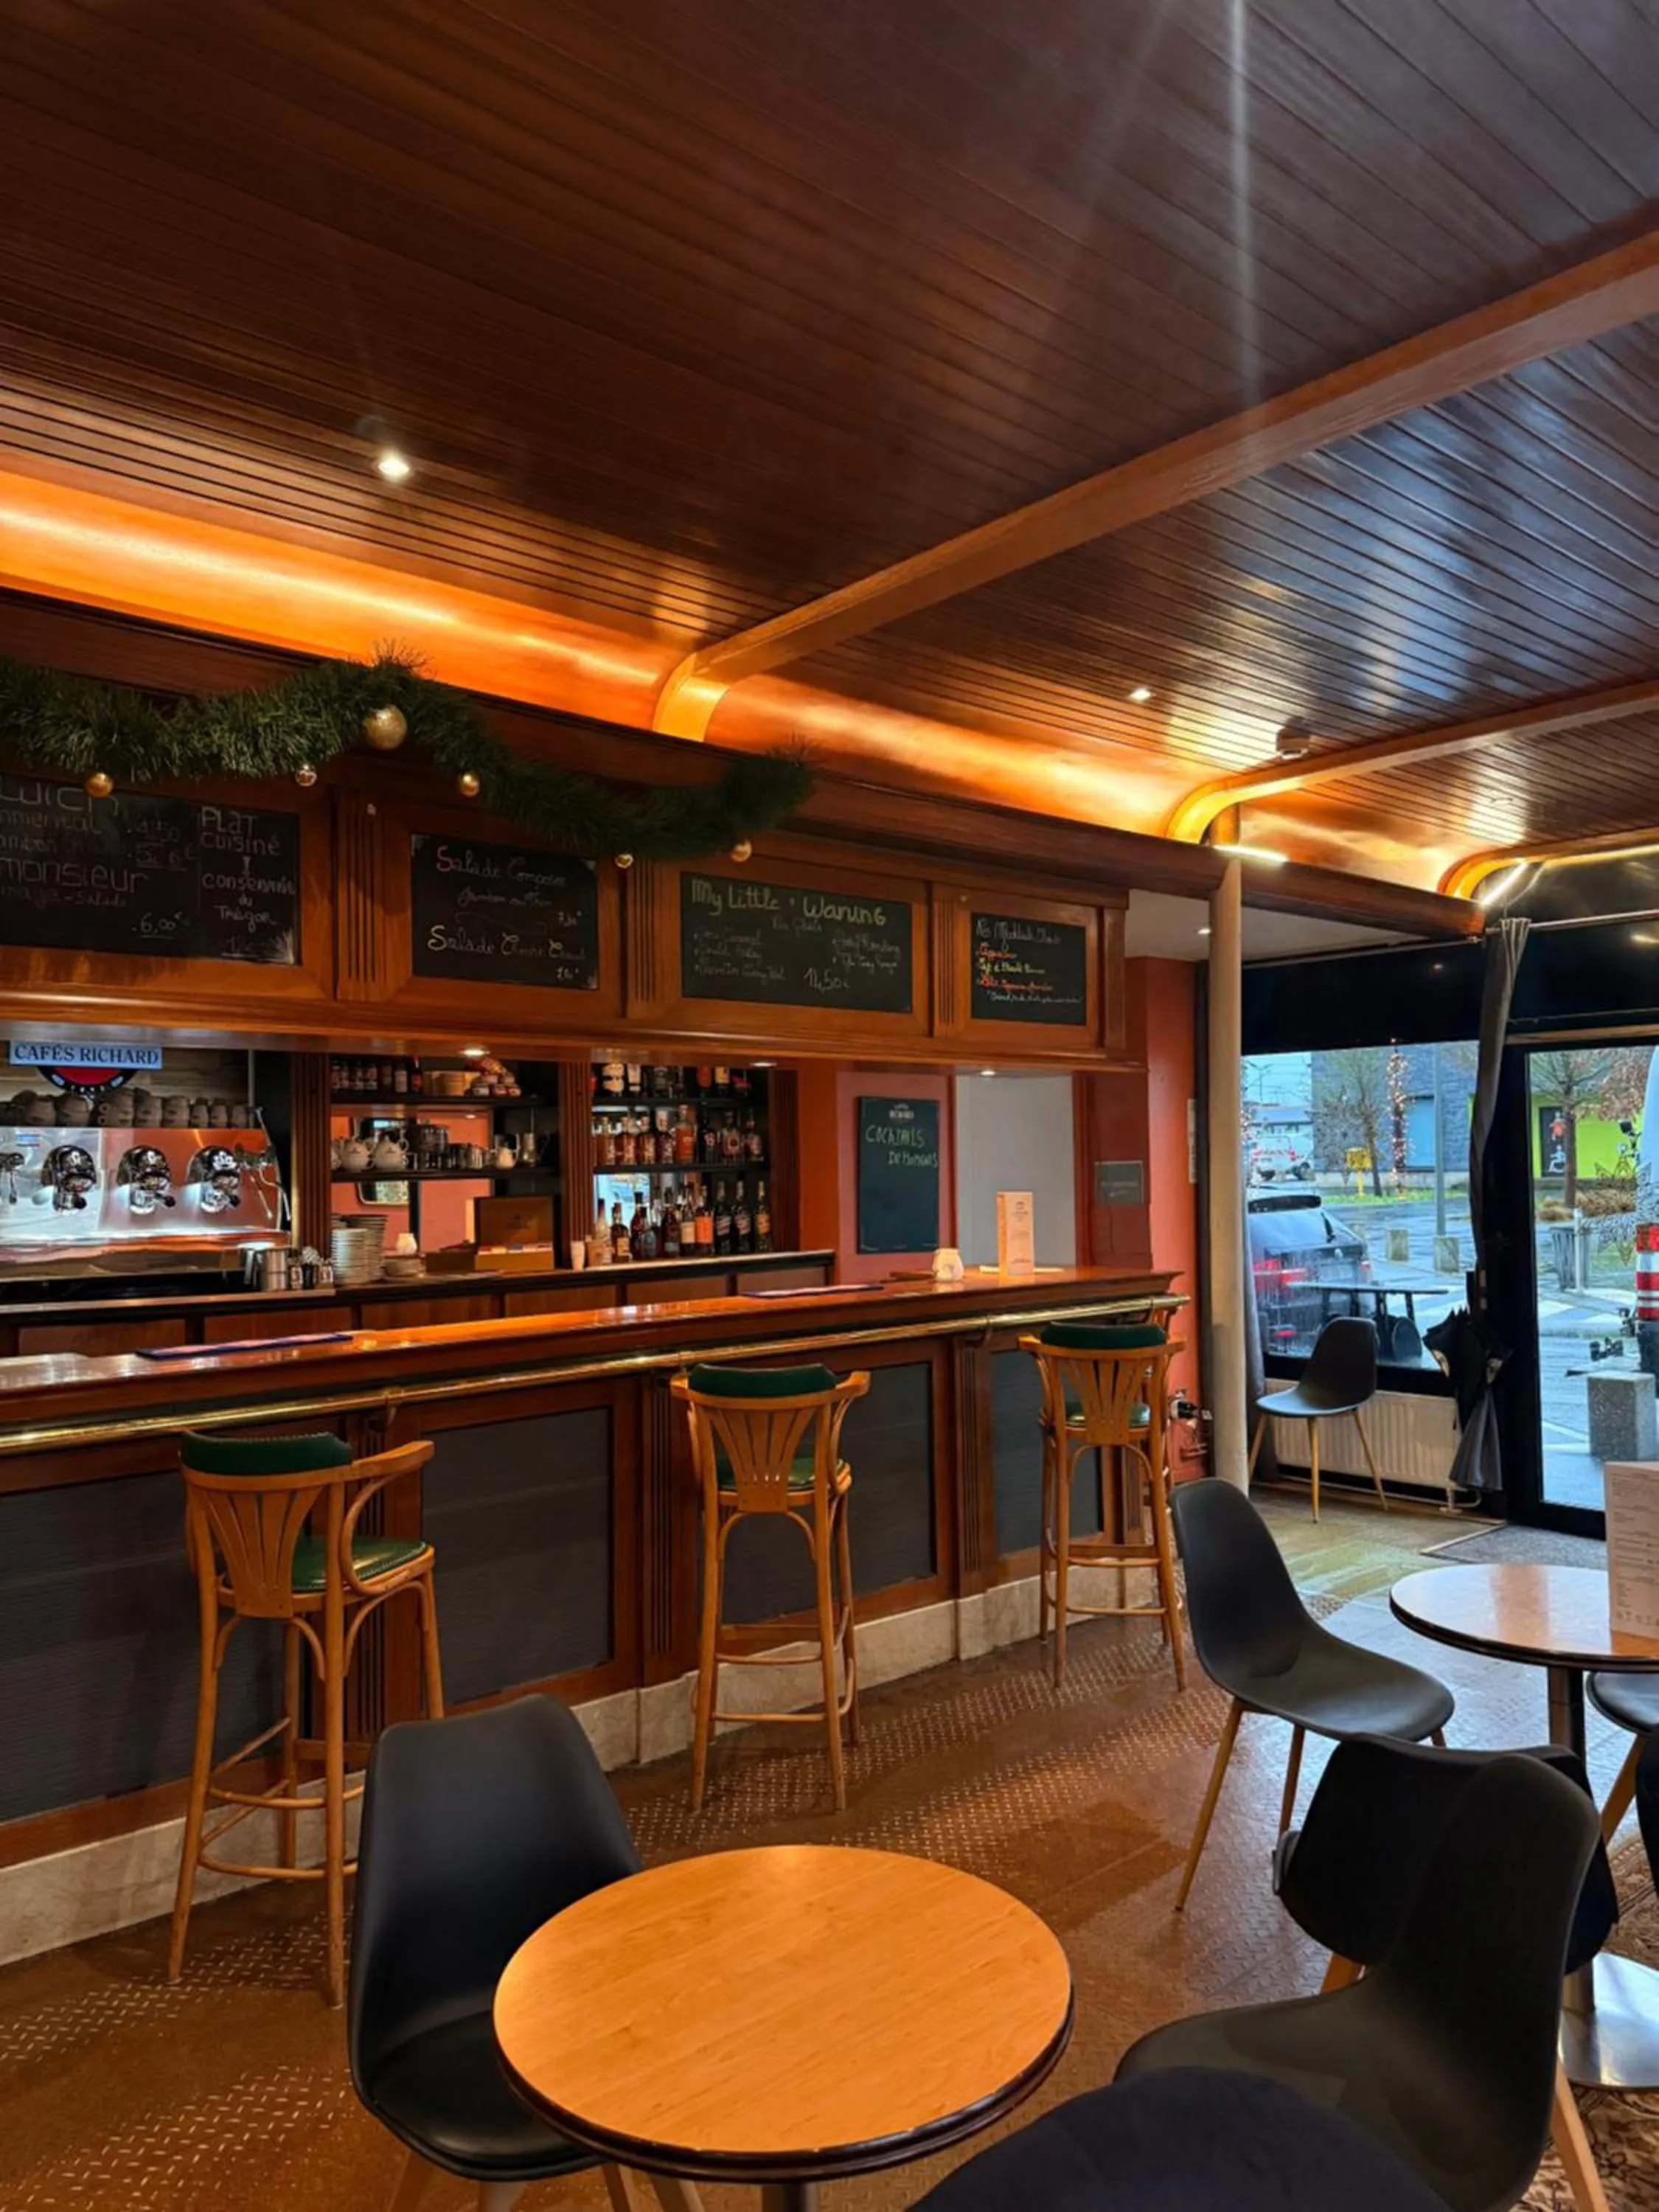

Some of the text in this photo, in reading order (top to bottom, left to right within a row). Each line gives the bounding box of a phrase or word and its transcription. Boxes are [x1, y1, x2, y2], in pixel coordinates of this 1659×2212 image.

[692, 878, 723, 917] My
[14, 1043, 159, 1064] CAFÉS RICHARD
